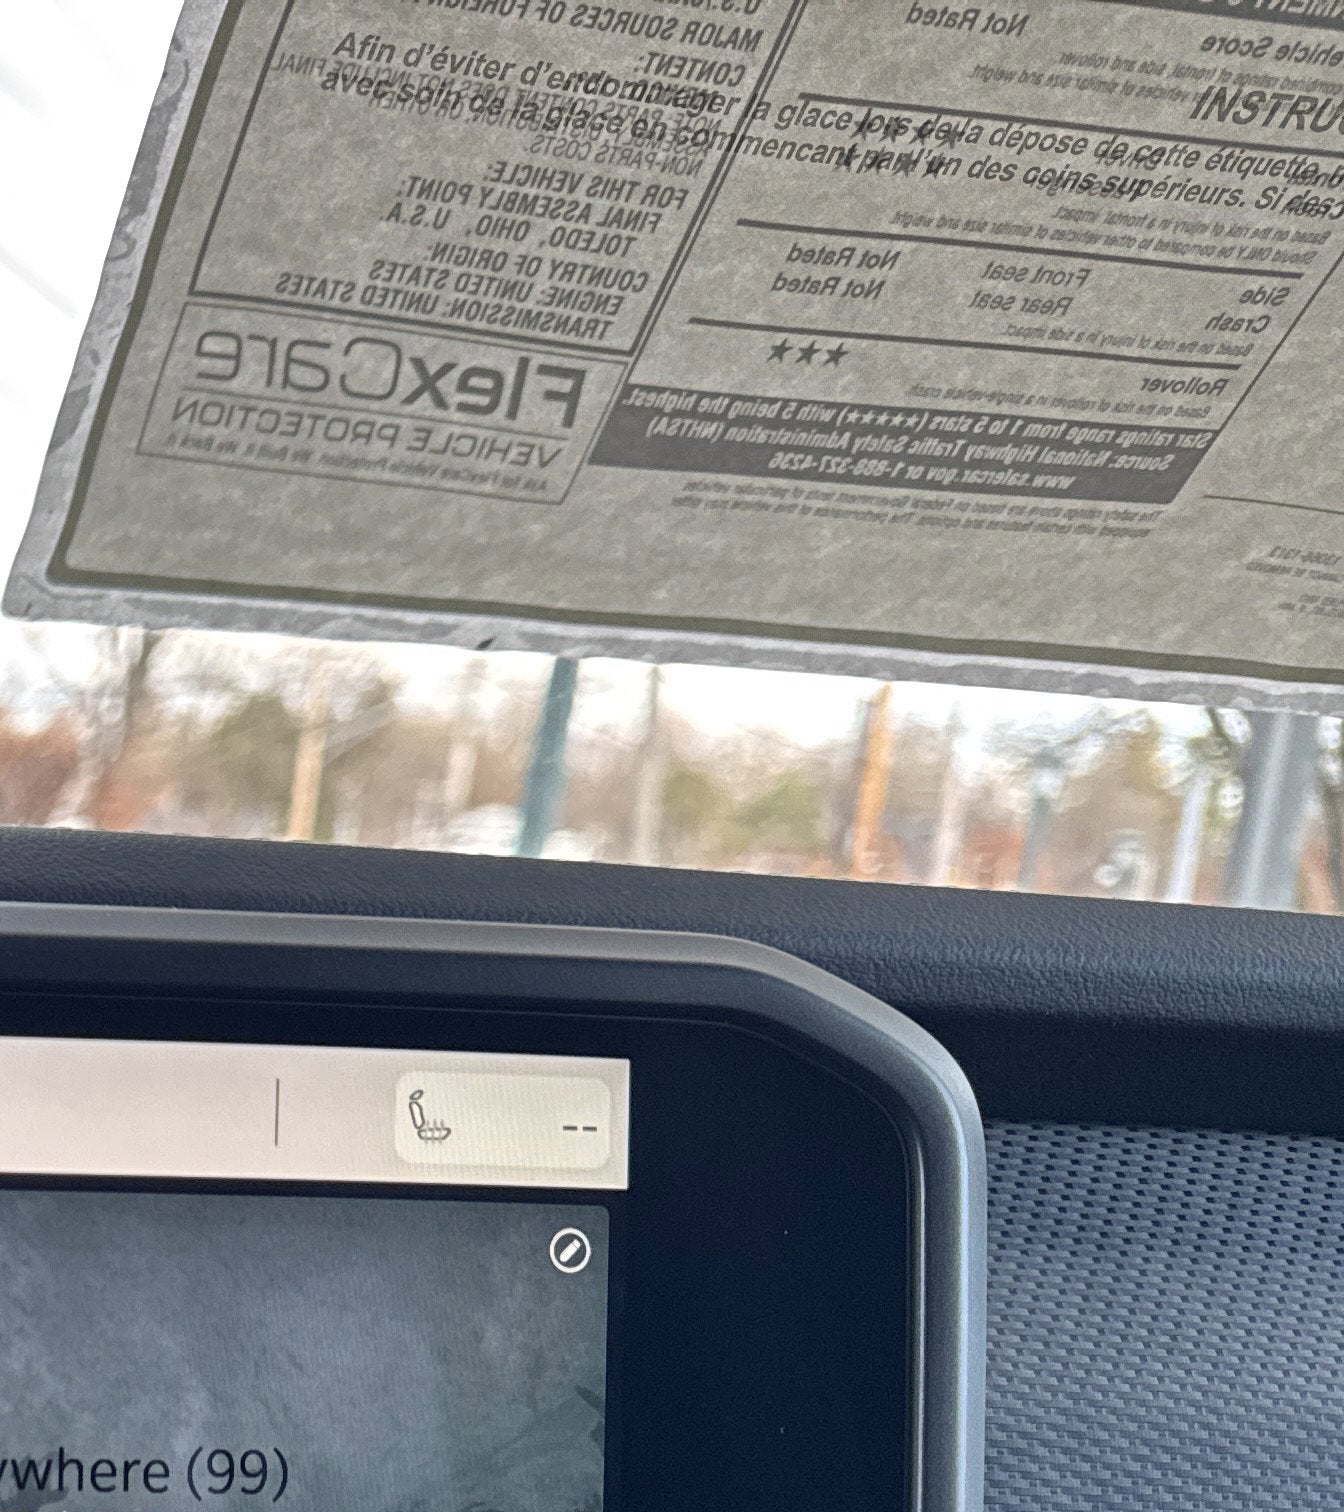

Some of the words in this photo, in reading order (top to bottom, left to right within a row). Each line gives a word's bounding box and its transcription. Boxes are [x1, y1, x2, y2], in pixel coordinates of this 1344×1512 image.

[333, 32, 395, 64] Afin
[403, 42, 516, 84] d'éviter
[743, 92, 772, 123] la
[774, 98, 853, 134] glace
[988, 121, 1089, 155] dépose
[1189, 85, 1344, 136] INSTRU
[321, 69, 388, 100] avec
[399, 80, 462, 111] soin
[967, 154, 1018, 182] des
[1254, 186, 1288, 211] Si
[186, 1447, 290, 1502] (99)
